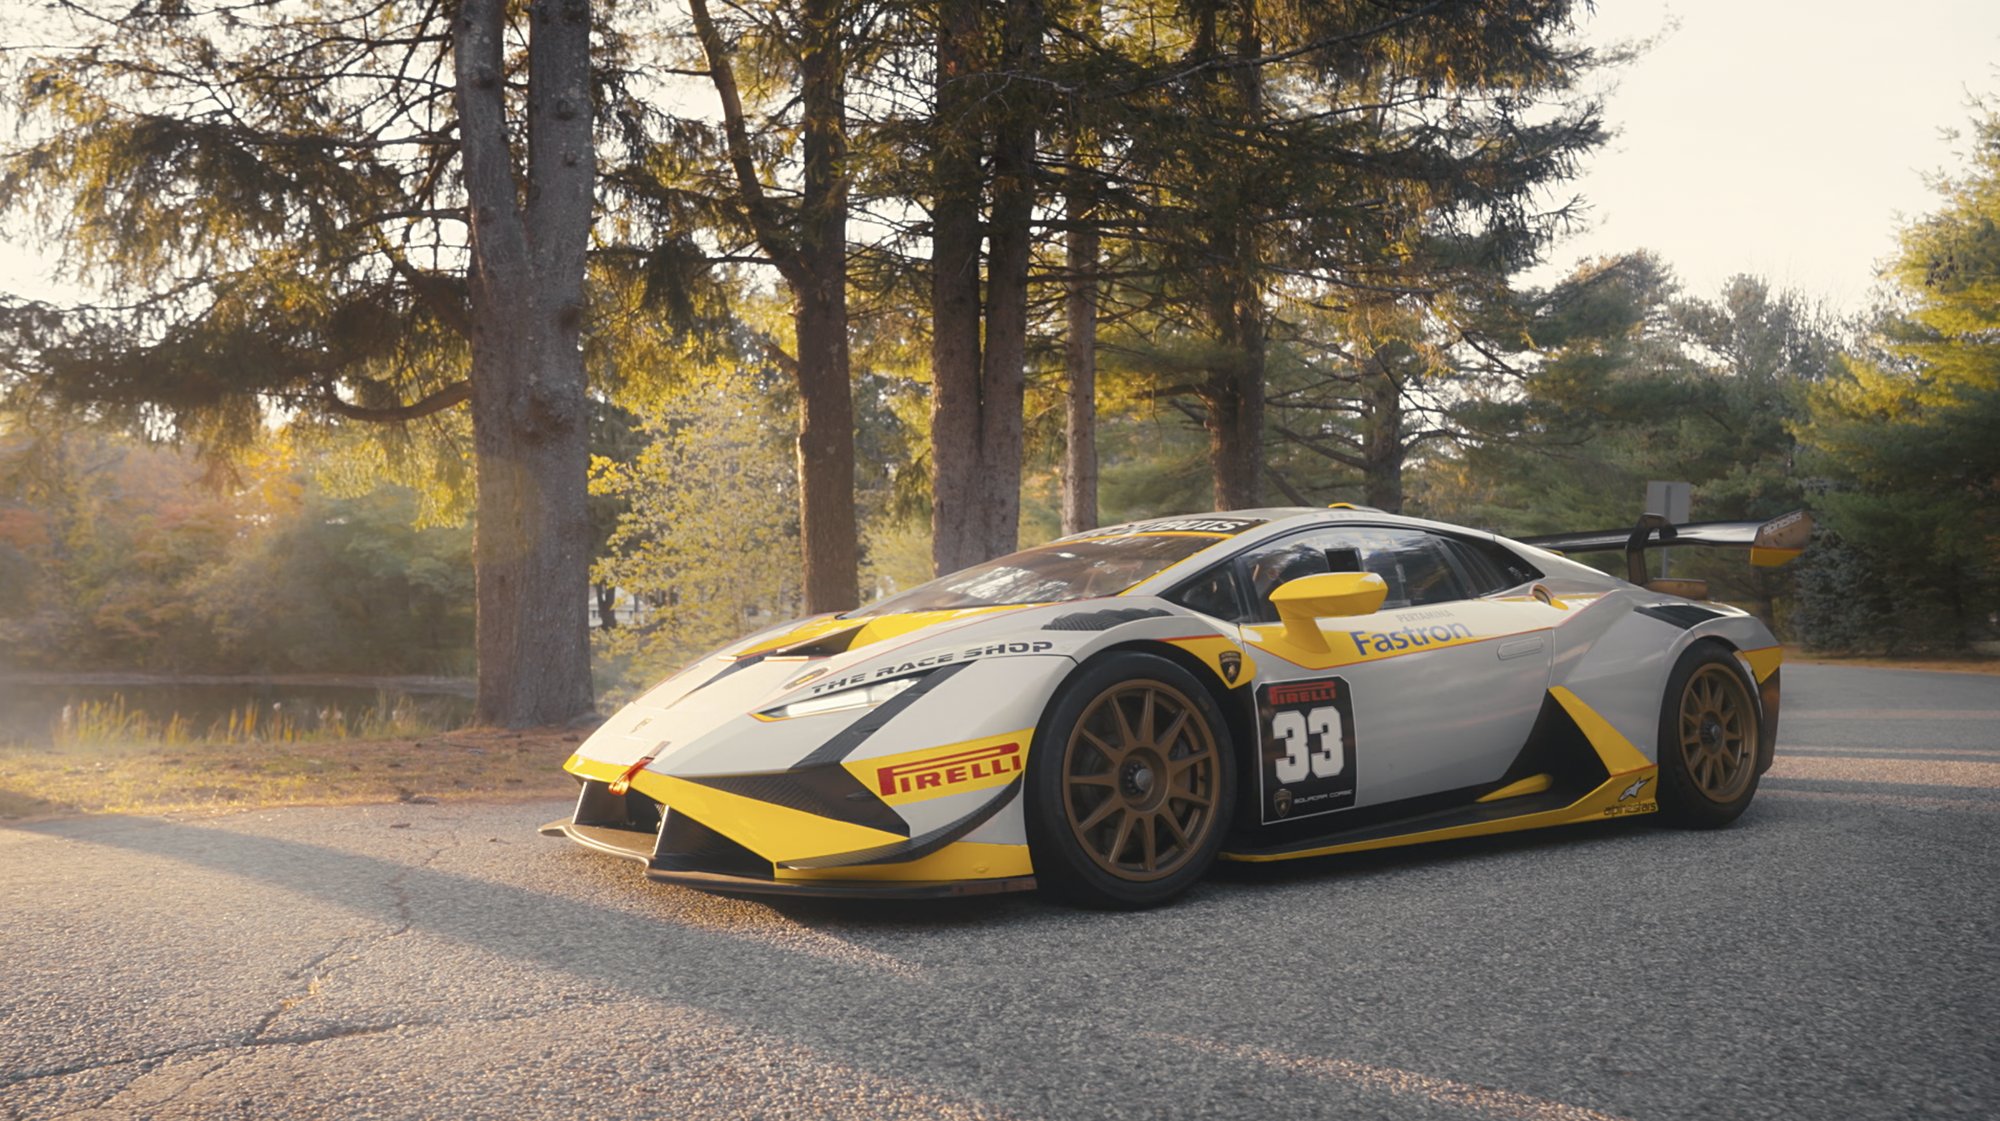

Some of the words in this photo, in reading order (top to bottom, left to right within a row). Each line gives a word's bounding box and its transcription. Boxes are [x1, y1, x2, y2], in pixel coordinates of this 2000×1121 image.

[1395, 609, 1455, 623] PERTAMINA
[1349, 622, 1473, 656] Fastron
[811, 673, 866, 694] THE
[876, 653, 954, 678] RACE
[964, 641, 1053, 659] SHOP
[1268, 681, 1336, 705] PIRELLI
[1272, 705, 1344, 784] 33
[877, 742, 1022, 796] PIRELLI
